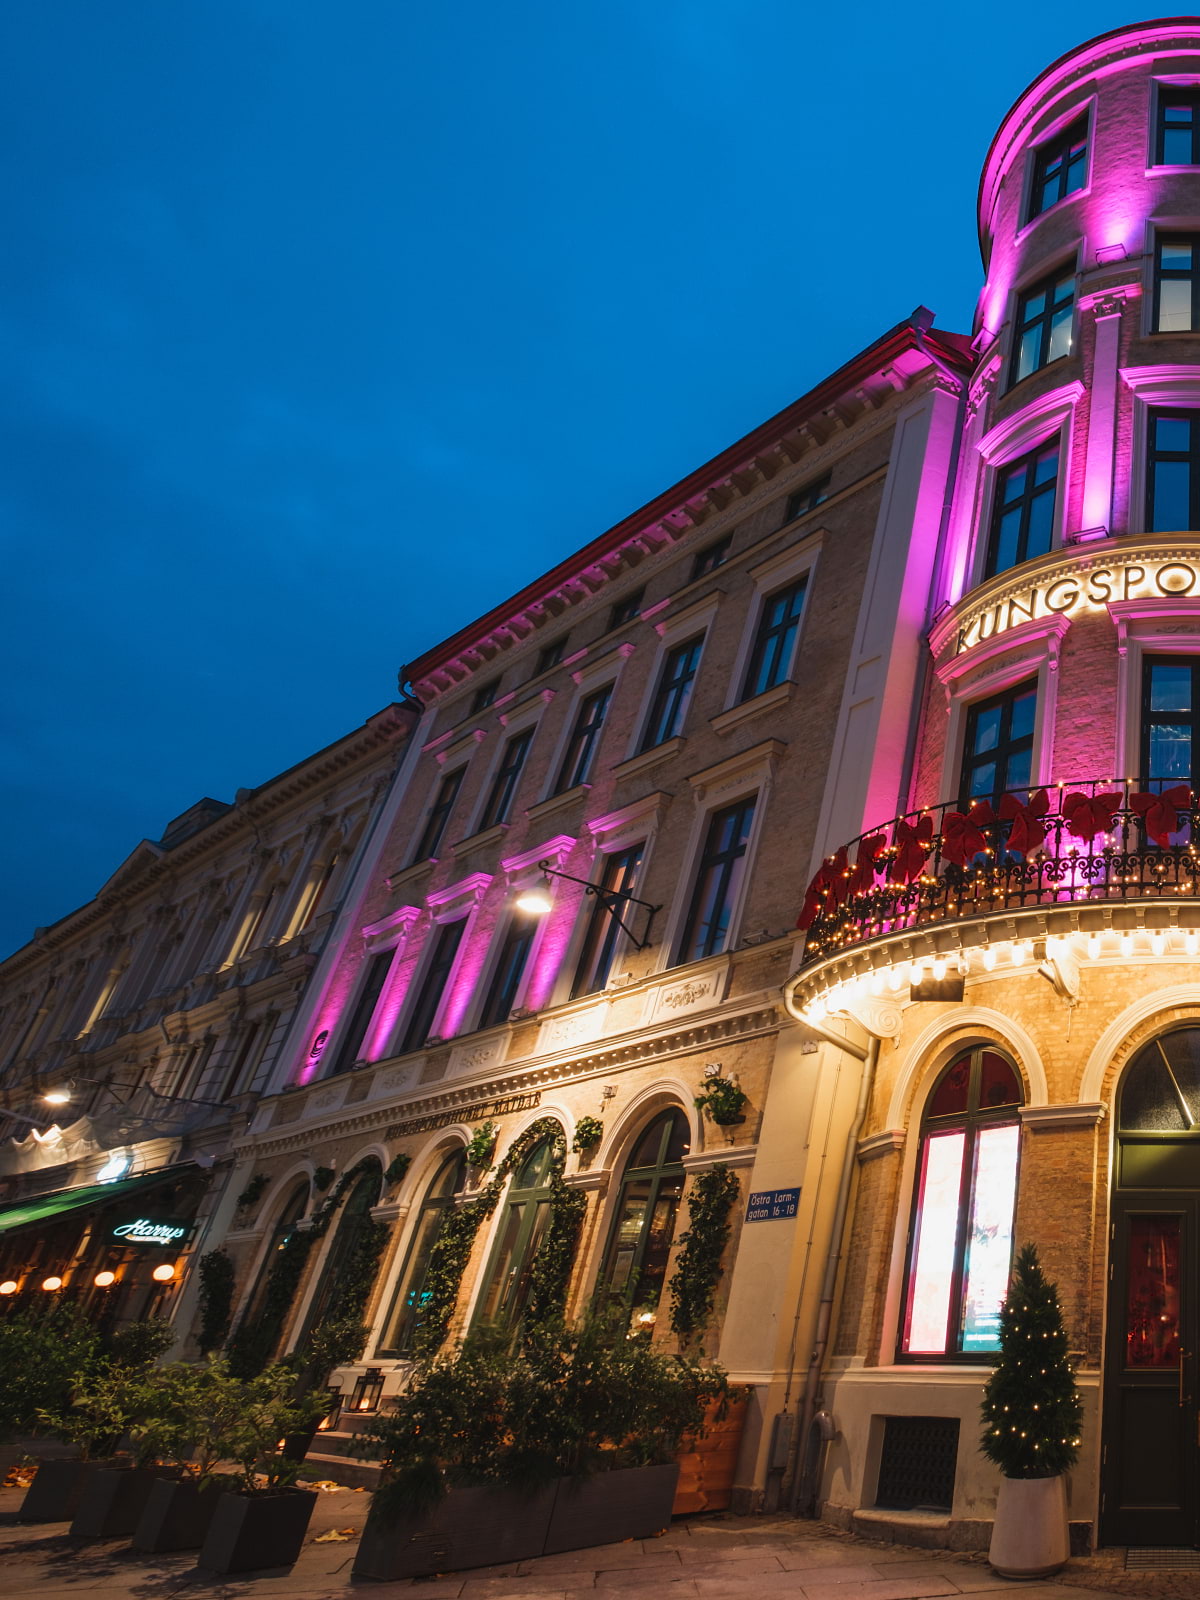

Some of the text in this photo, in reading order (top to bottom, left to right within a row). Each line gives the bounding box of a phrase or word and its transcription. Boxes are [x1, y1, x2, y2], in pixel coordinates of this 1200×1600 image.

[751, 1193, 795, 1206] Östra Larm-
[748, 1209, 769, 1221] gatan
[113, 1219, 185, 1244] Harrys
